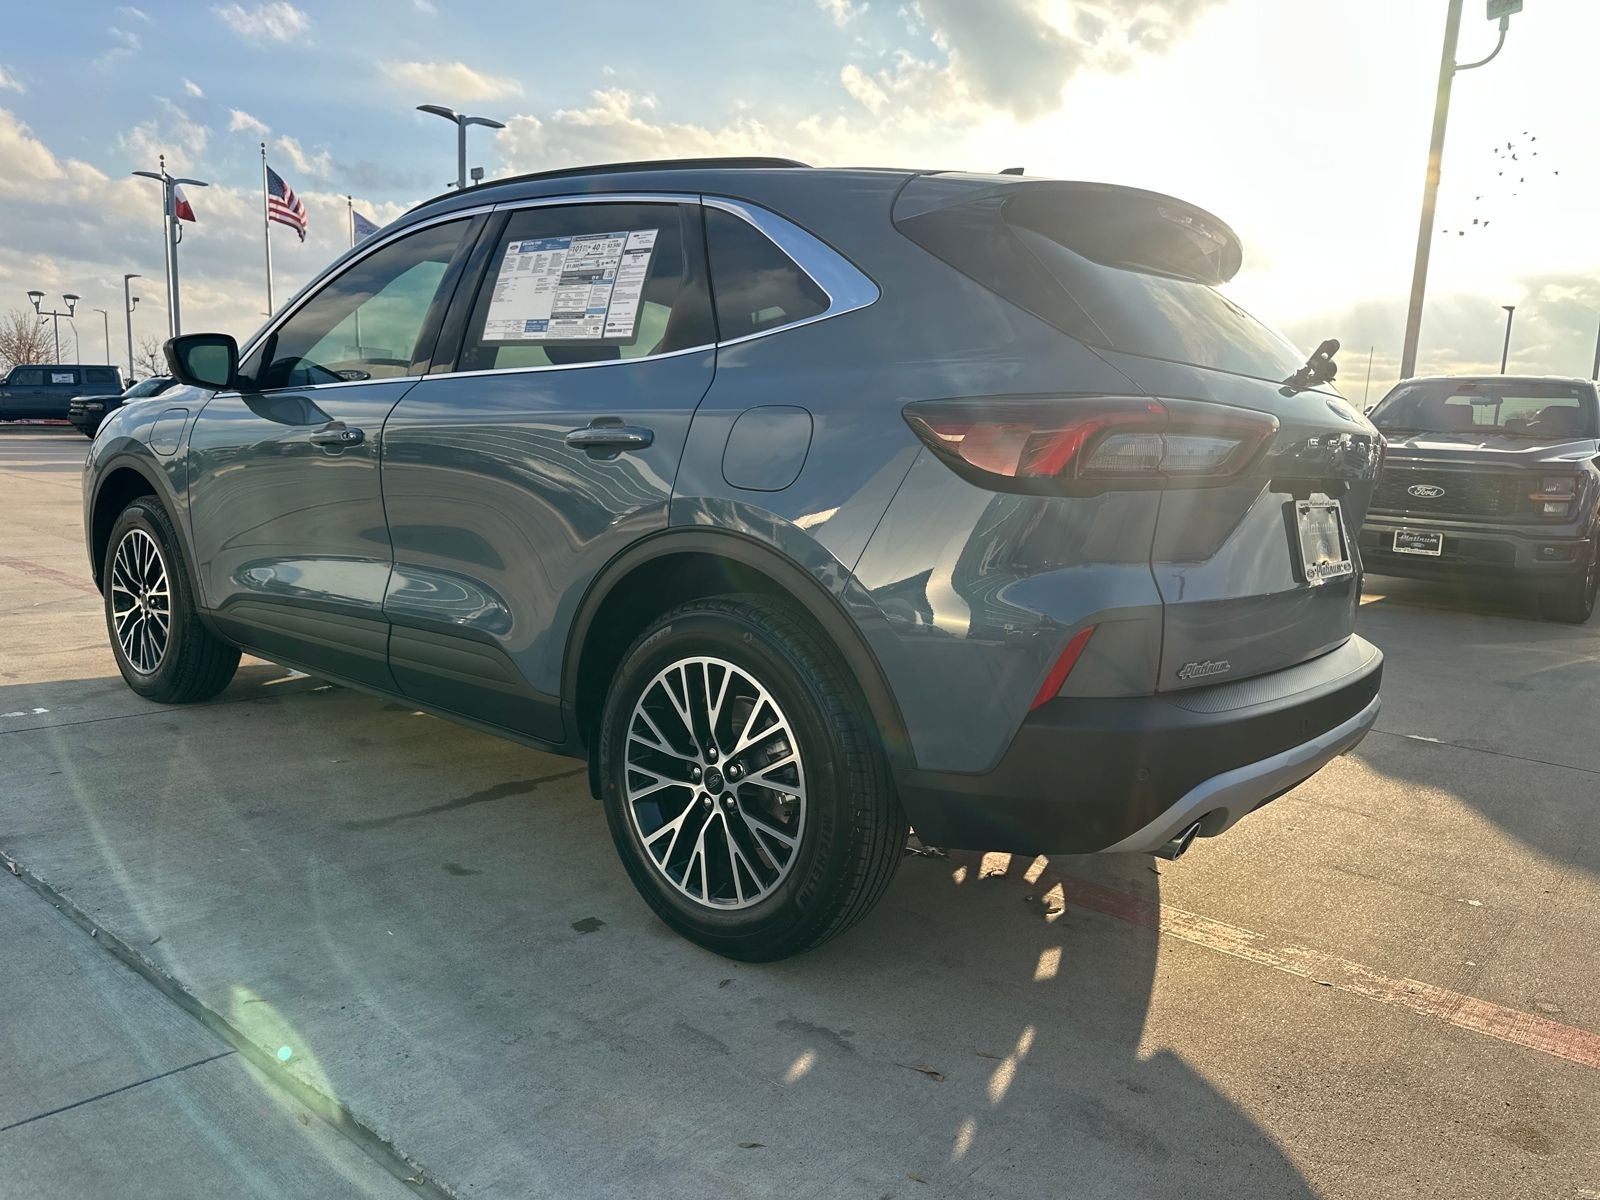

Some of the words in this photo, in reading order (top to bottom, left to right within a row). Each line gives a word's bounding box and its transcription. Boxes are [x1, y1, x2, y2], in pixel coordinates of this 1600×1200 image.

[1414, 486, 1438, 496] Ford
[1398, 534, 1438, 543] Platinum
[1314, 563, 1344, 577] Platinum
[1179, 660, 1231, 679] Platinum
[797, 812, 834, 902] MICHELIN
